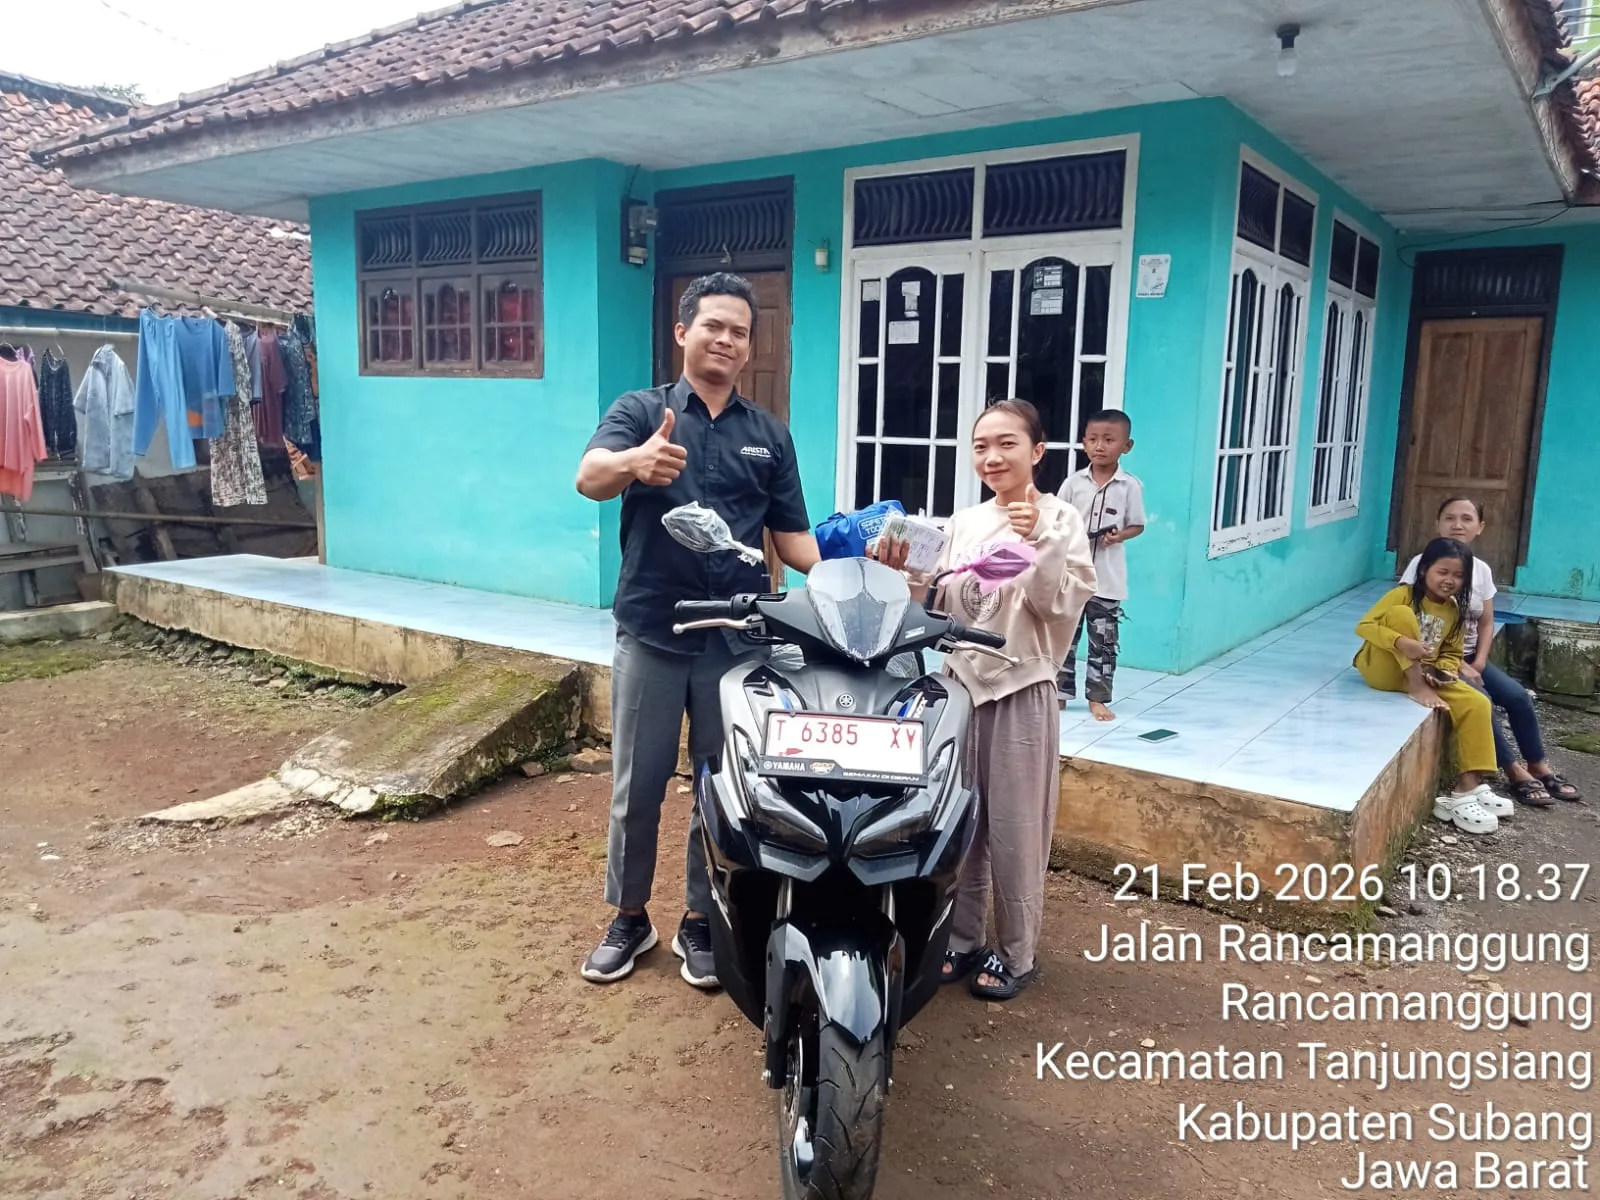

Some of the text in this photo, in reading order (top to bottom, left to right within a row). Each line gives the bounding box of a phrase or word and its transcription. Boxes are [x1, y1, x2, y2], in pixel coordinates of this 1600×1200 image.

[777, 720, 917, 750] T 6385 XY
[773, 761, 806, 772] YAMAHA
